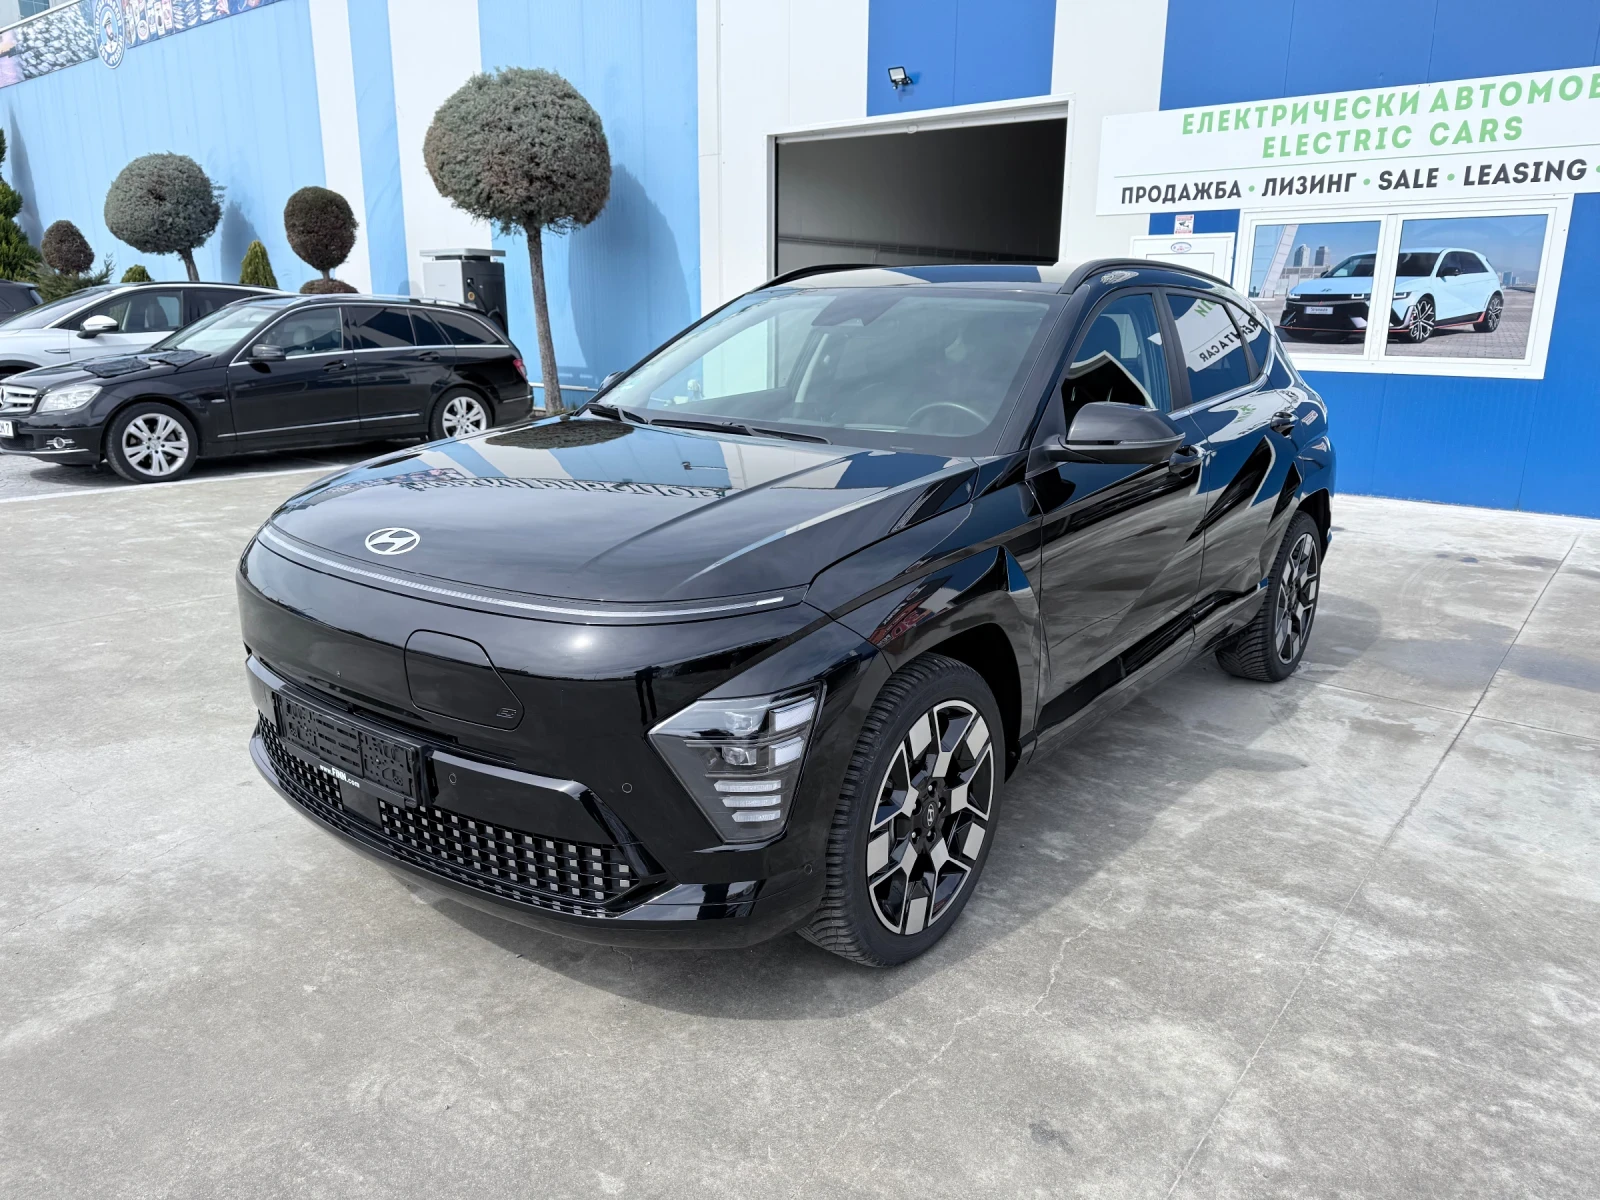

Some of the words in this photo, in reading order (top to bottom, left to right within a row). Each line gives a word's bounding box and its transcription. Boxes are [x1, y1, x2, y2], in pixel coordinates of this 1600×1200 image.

[1182, 90, 1420, 134] ЕЛЕКТРИЧЕСКИ
[1262, 125, 1413, 158] ELECTRIC
[1429, 116, 1523, 146] CARS
[1121, 180, 1242, 204] ПРОДАЖБА
[1261, 172, 1357, 196] ЛИЗИНГ
[1378, 167, 1439, 190] SALE
[1463, 158, 1587, 186] LEASING
